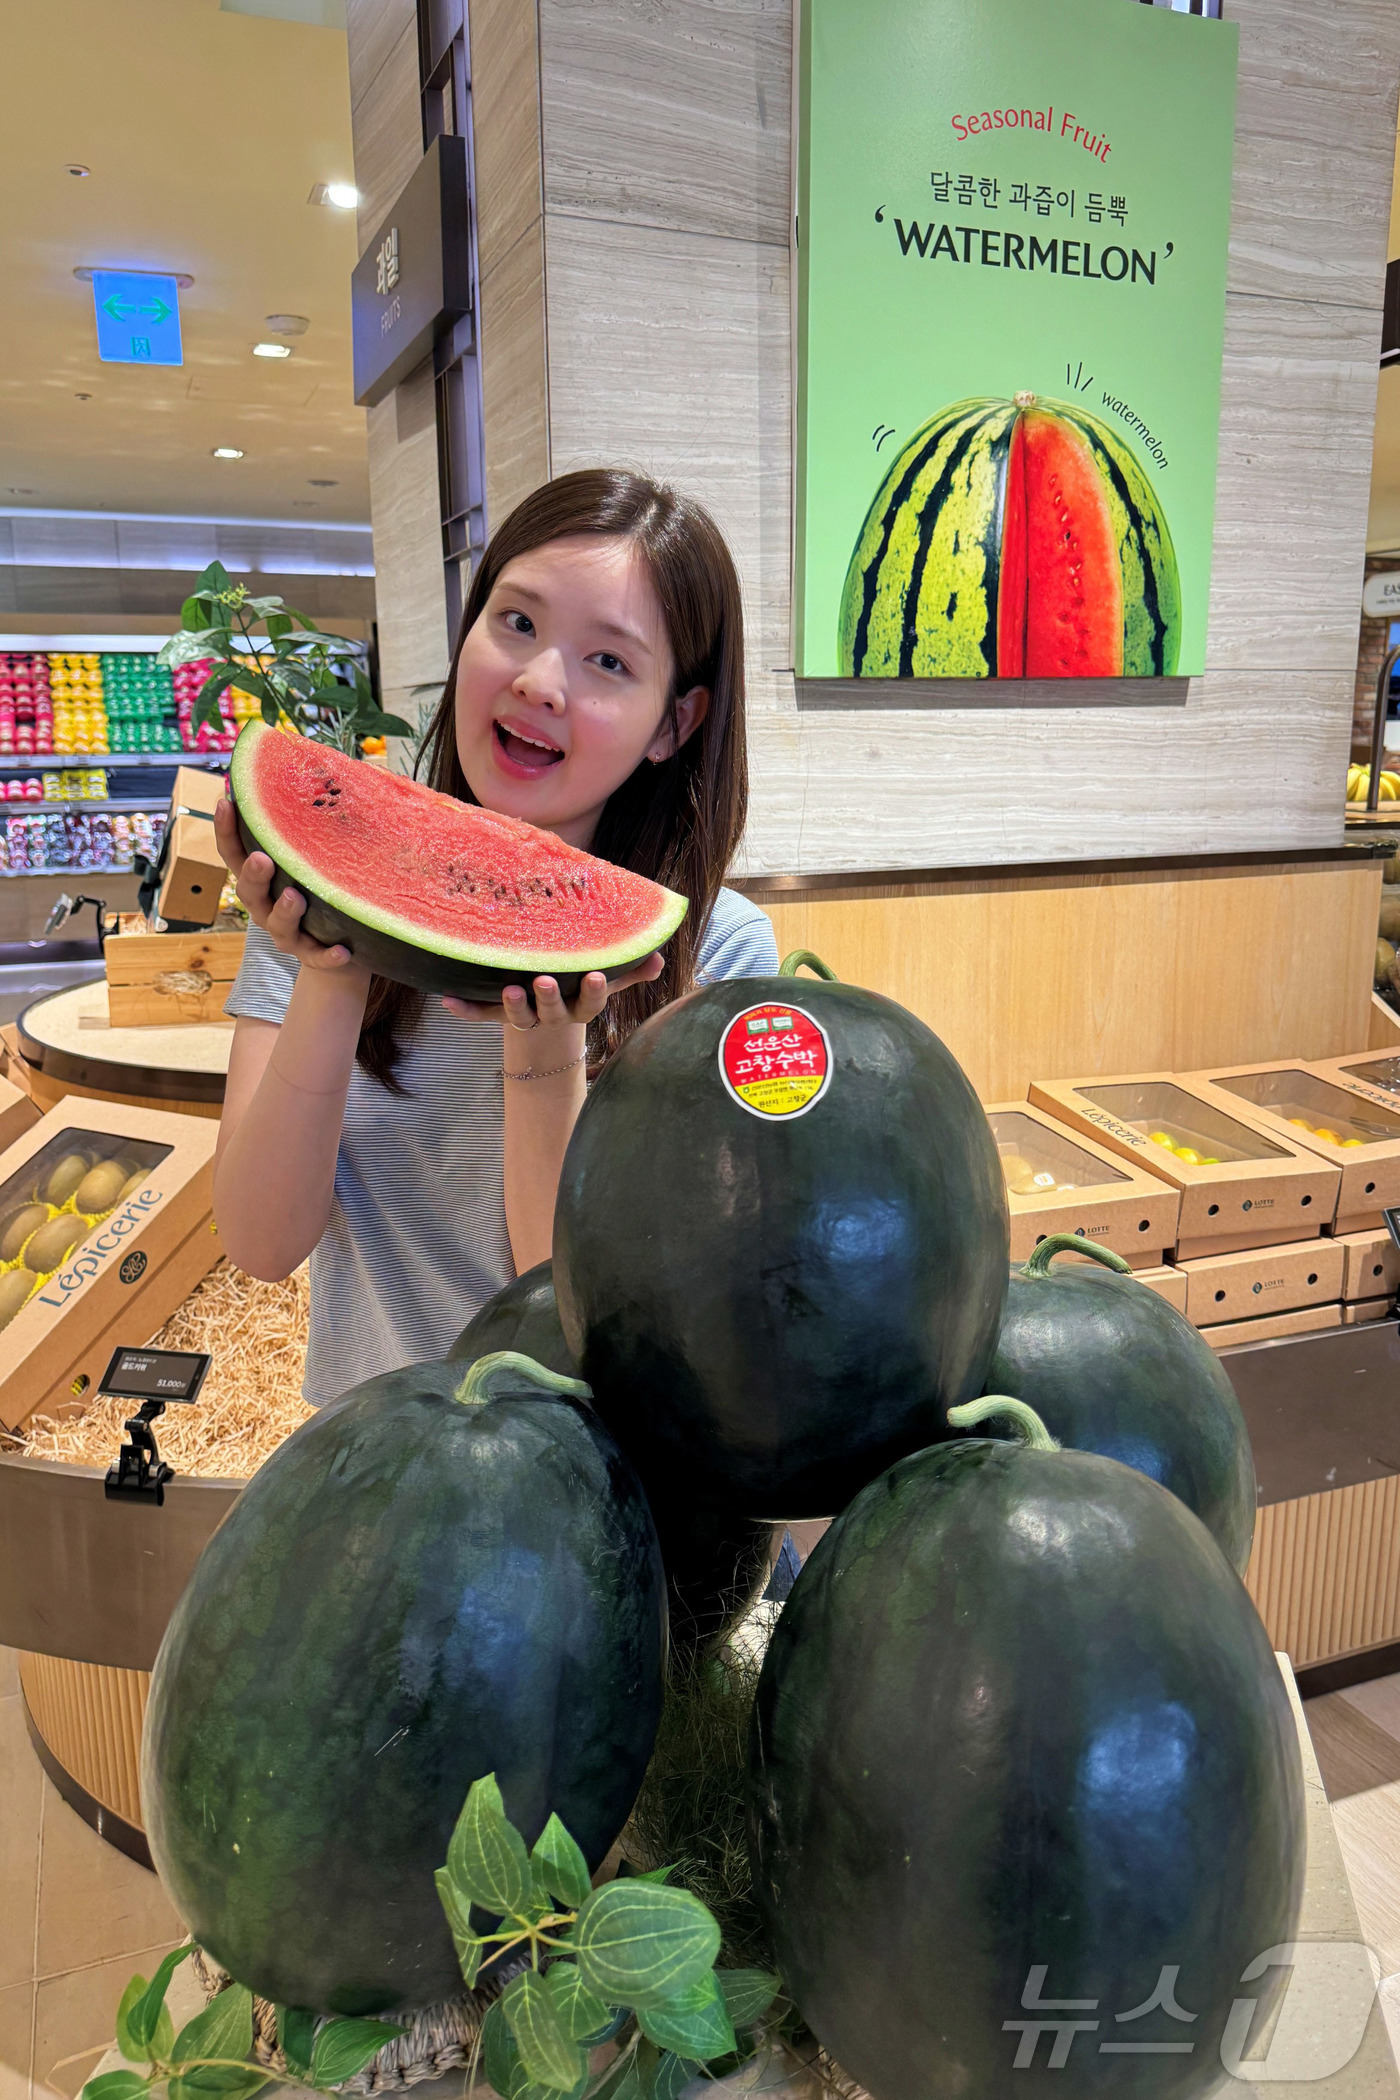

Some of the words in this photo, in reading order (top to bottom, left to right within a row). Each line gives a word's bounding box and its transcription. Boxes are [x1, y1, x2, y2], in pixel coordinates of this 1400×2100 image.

[951, 107, 1053, 141] Seasonal
[1061, 113, 1112, 163] Fruit
[931, 171, 1001, 209] 달콤한
[1009, 182, 1075, 217] 과즙이
[1084, 193, 1129, 227] 듬뿍
[376, 228, 400, 295] 과일
[381, 296, 401, 338] FRUITS
[1102, 392, 1168, 470] watermelon
[735, 1050, 818, 1074] 고창수박
[743, 1033, 803, 1052] 선운산
[1087, 1225, 1111, 1234] LOTTE
[1264, 1279, 1285, 1287] LOTTE
